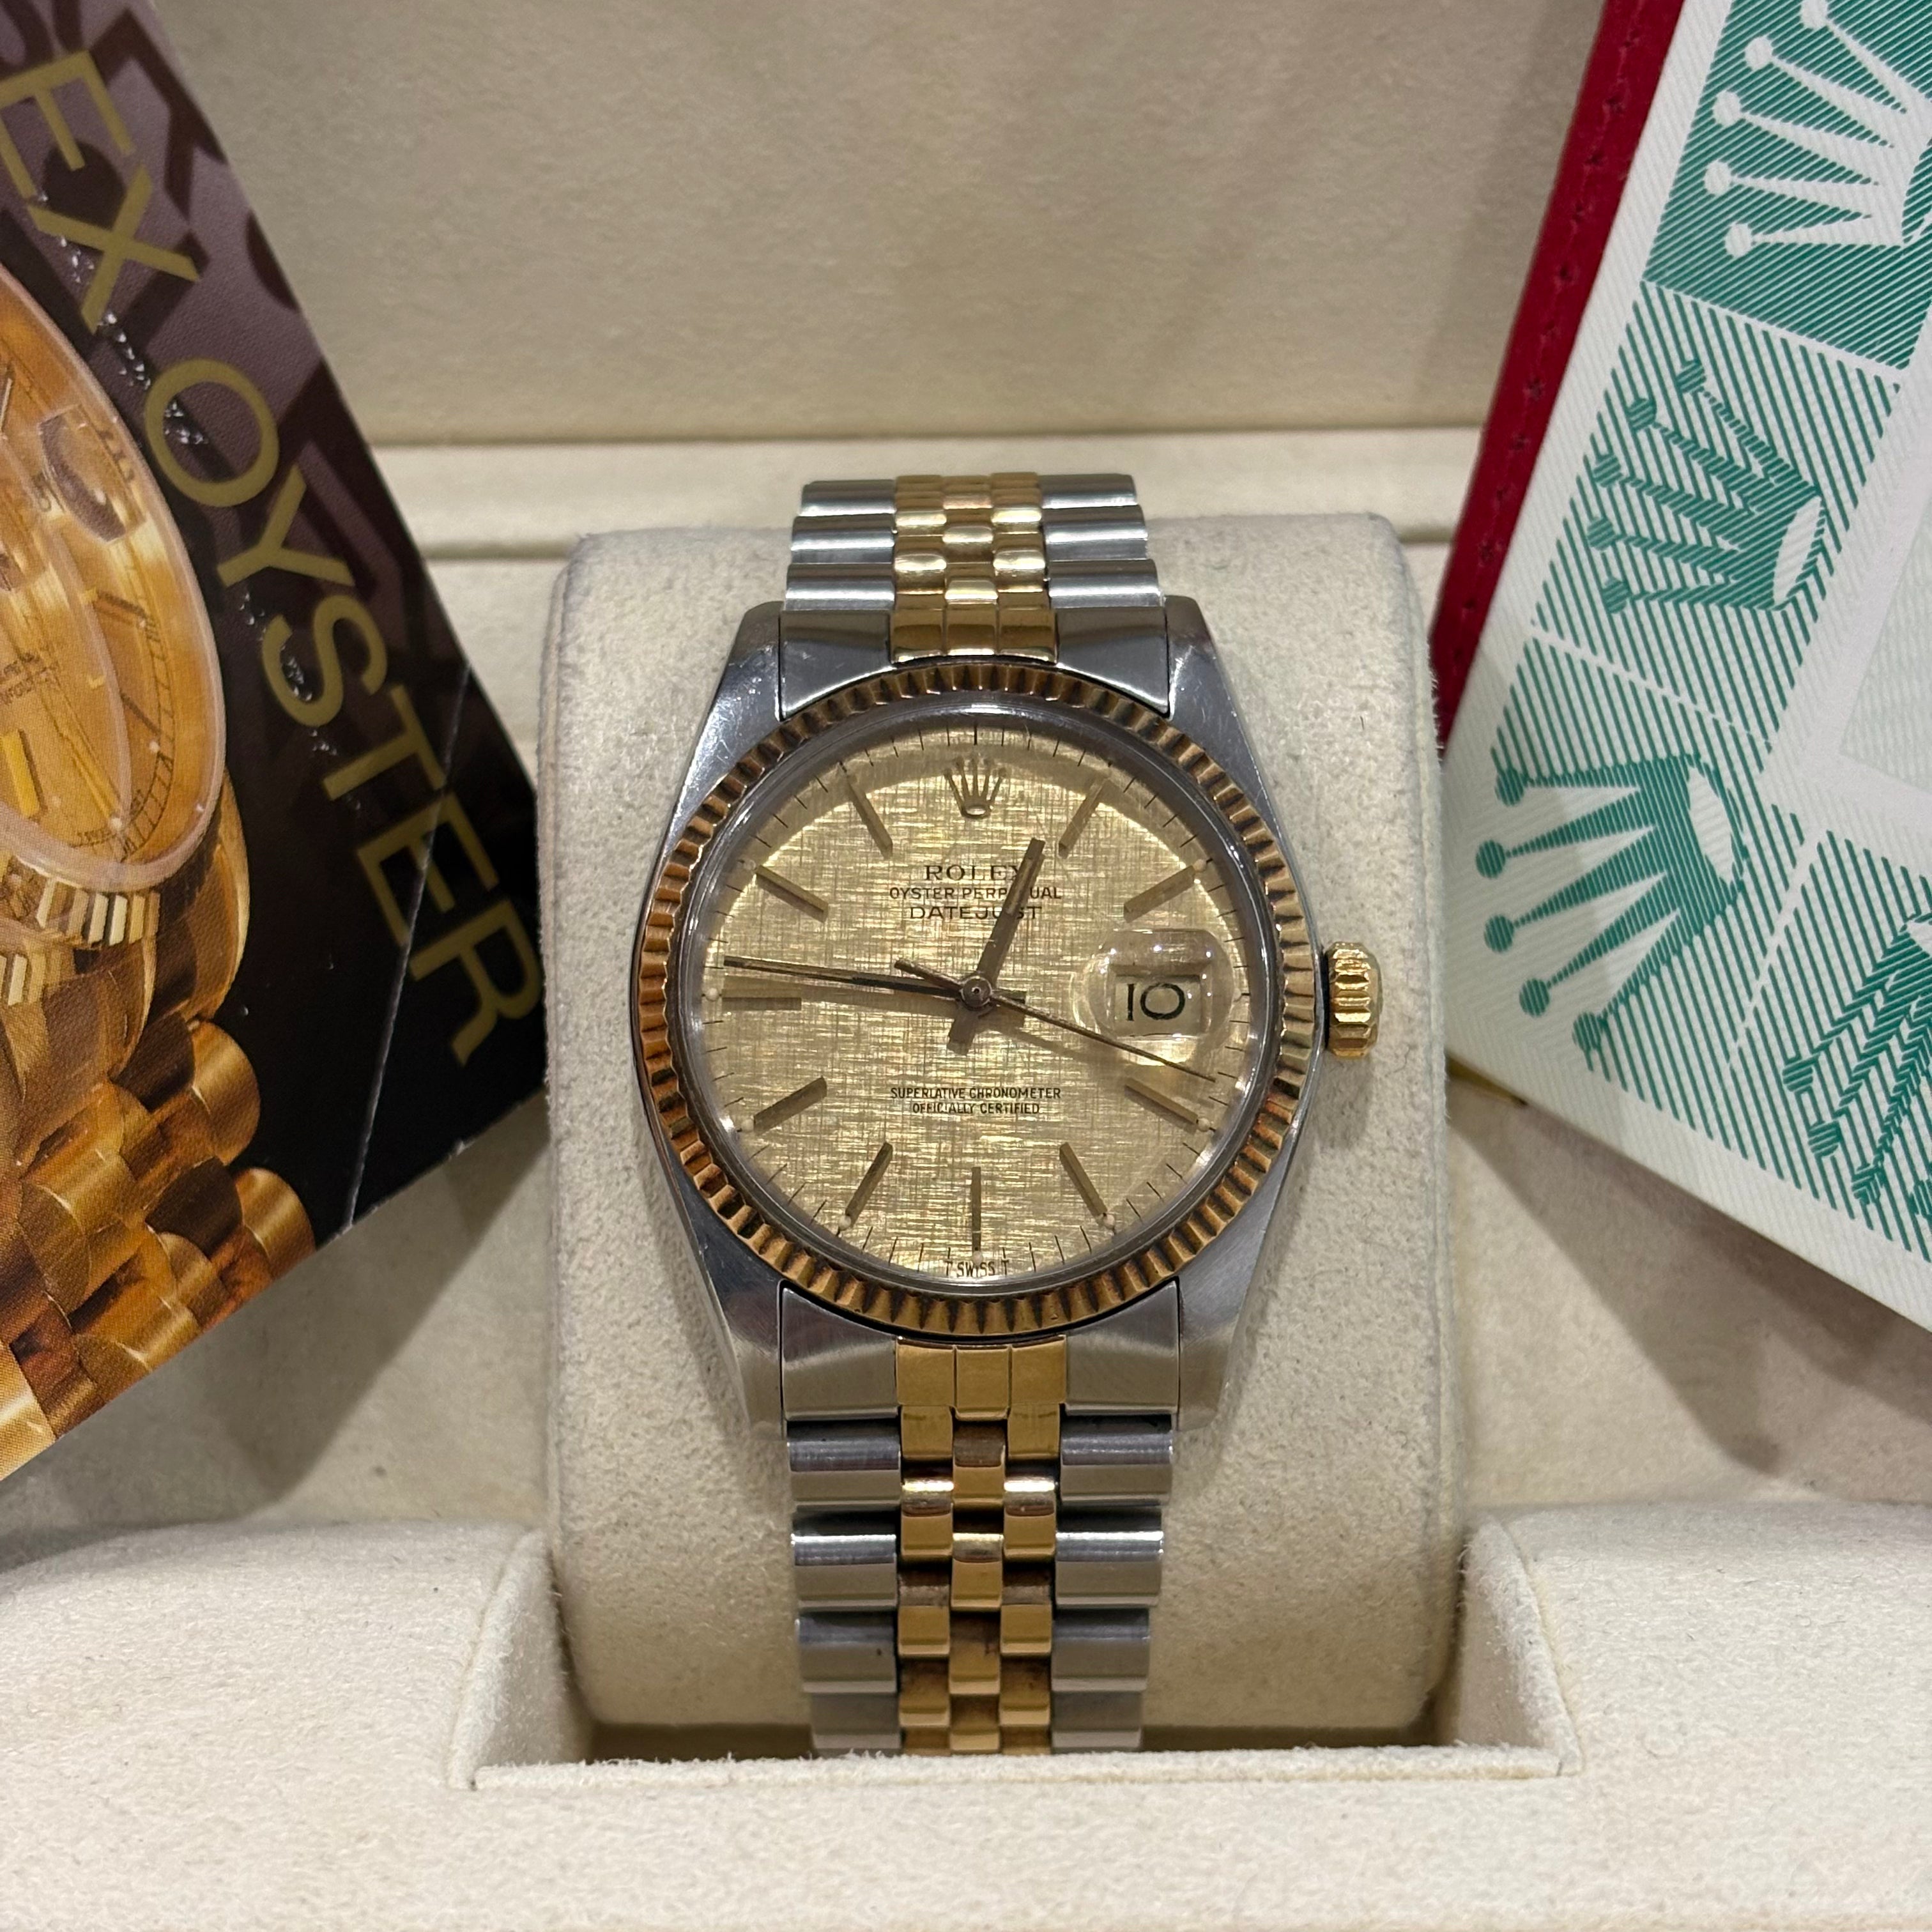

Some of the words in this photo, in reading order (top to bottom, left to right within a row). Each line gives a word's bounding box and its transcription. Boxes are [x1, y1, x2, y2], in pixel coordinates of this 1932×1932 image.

[145, 356, 543, 1067] OYSTER
[889, 887, 955, 900] OYSTER
[962, 887, 1061, 900] PERPUAL
[1127, 983, 1185, 1021] 10
[891, 1087, 965, 1099] SUPERLATIVE
[969, 1087, 1061, 1099] CHRONOMETER
[912, 1103, 974, 1114] OFFICIALLY
[979, 1103, 1040, 1114] CERTIFIED
